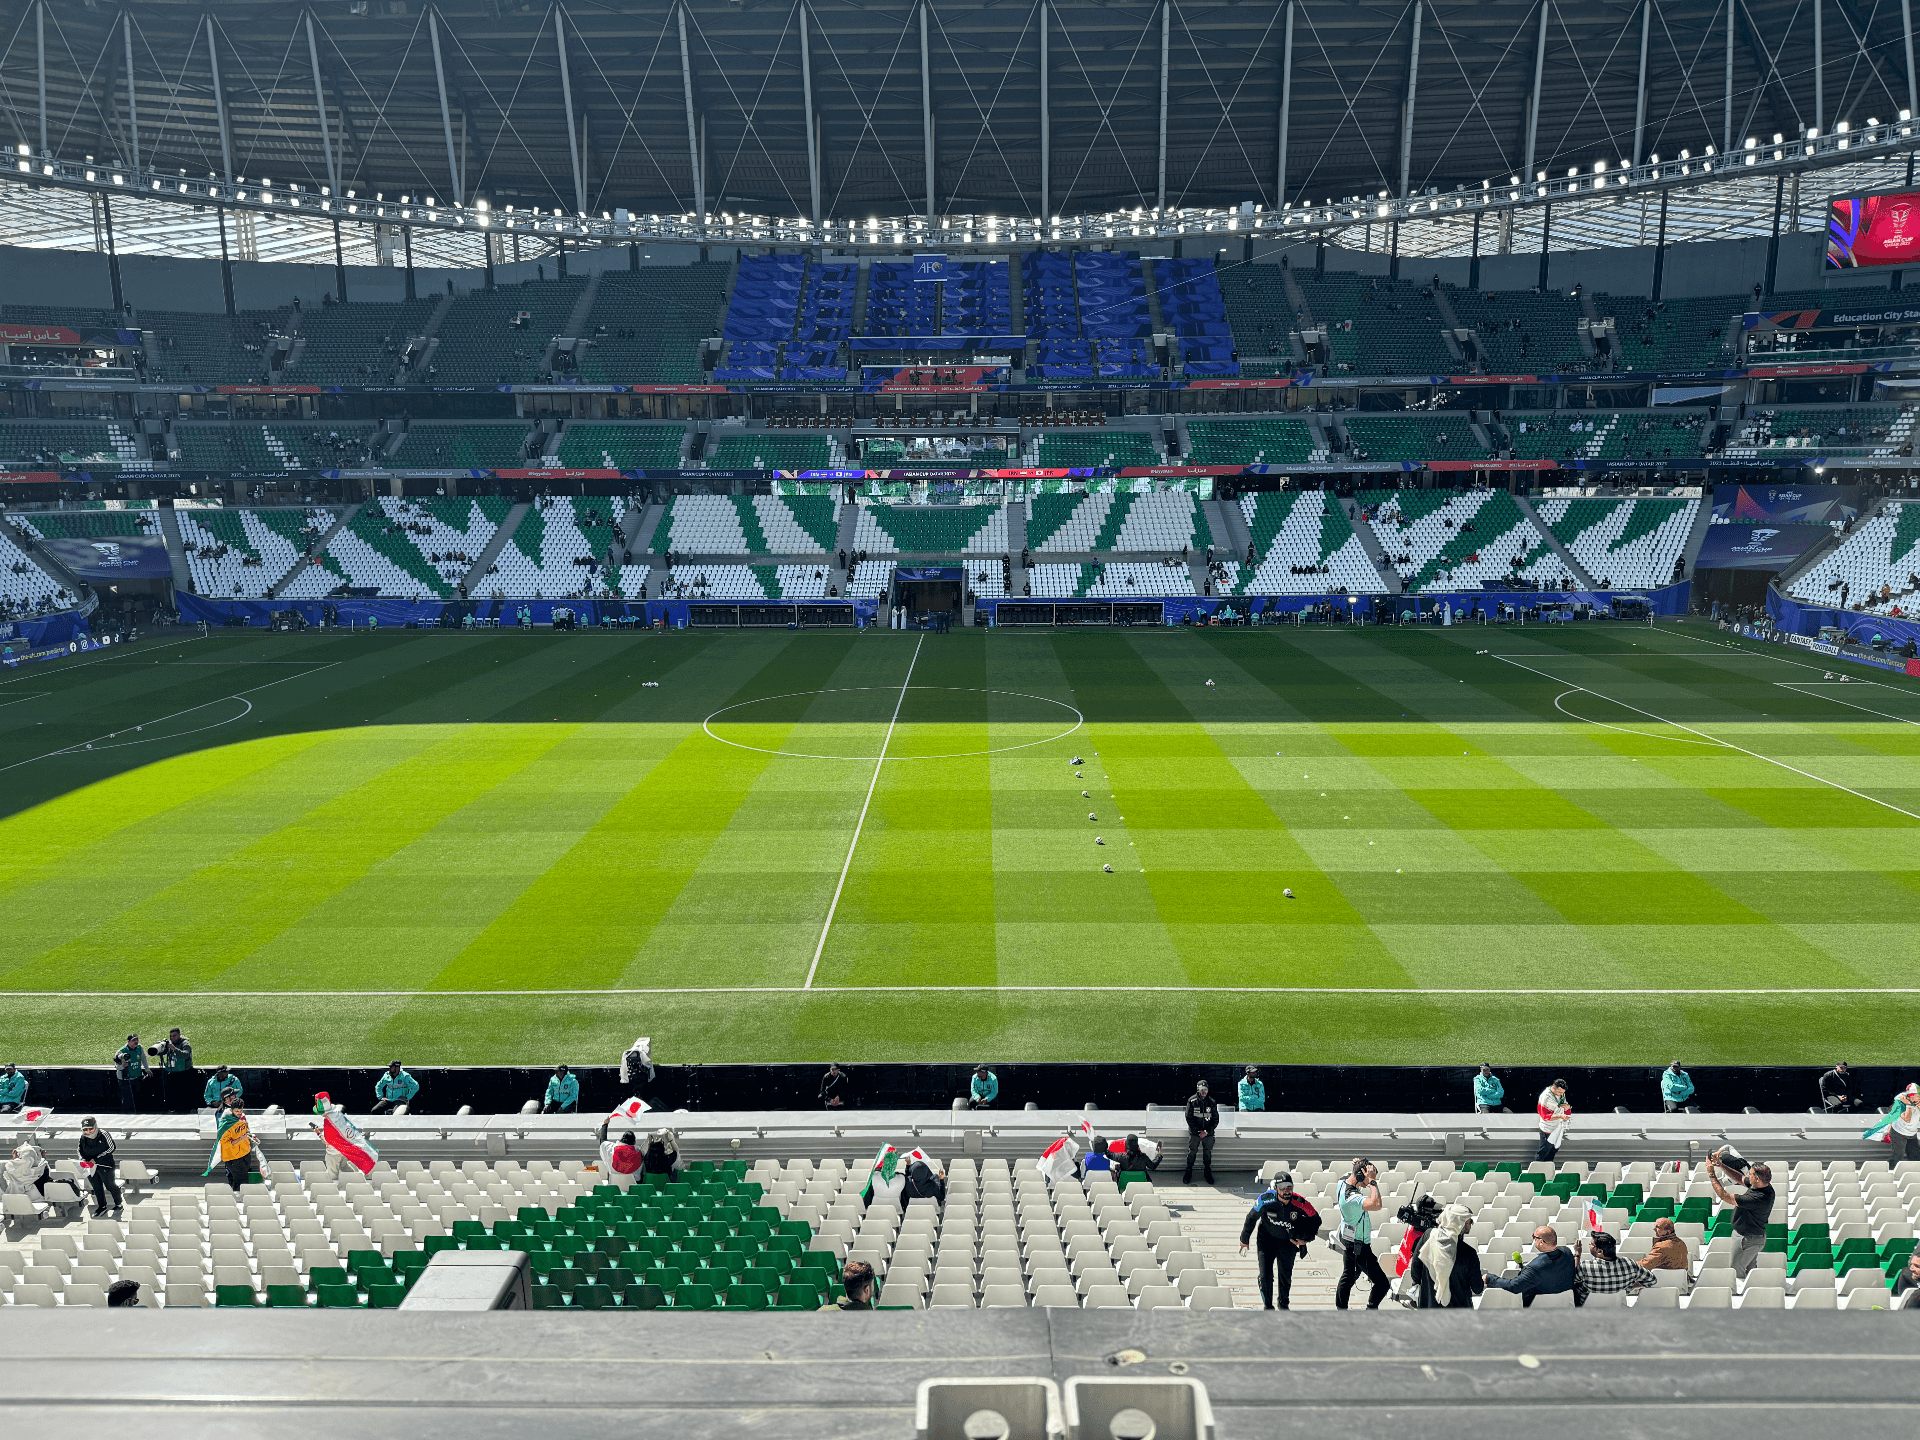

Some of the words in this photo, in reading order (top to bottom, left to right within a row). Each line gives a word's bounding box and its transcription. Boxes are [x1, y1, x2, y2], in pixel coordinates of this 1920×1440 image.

[917, 261, 943, 274] AFC
[1833, 312, 1882, 323] Education
[1883, 311, 1903, 321] City
[1903, 310, 1920, 318] Sta
[34, 330, 61, 341] كأس
[1790, 633, 1813, 646] FANTASY
[1812, 641, 1838, 655] FOOTBALL
